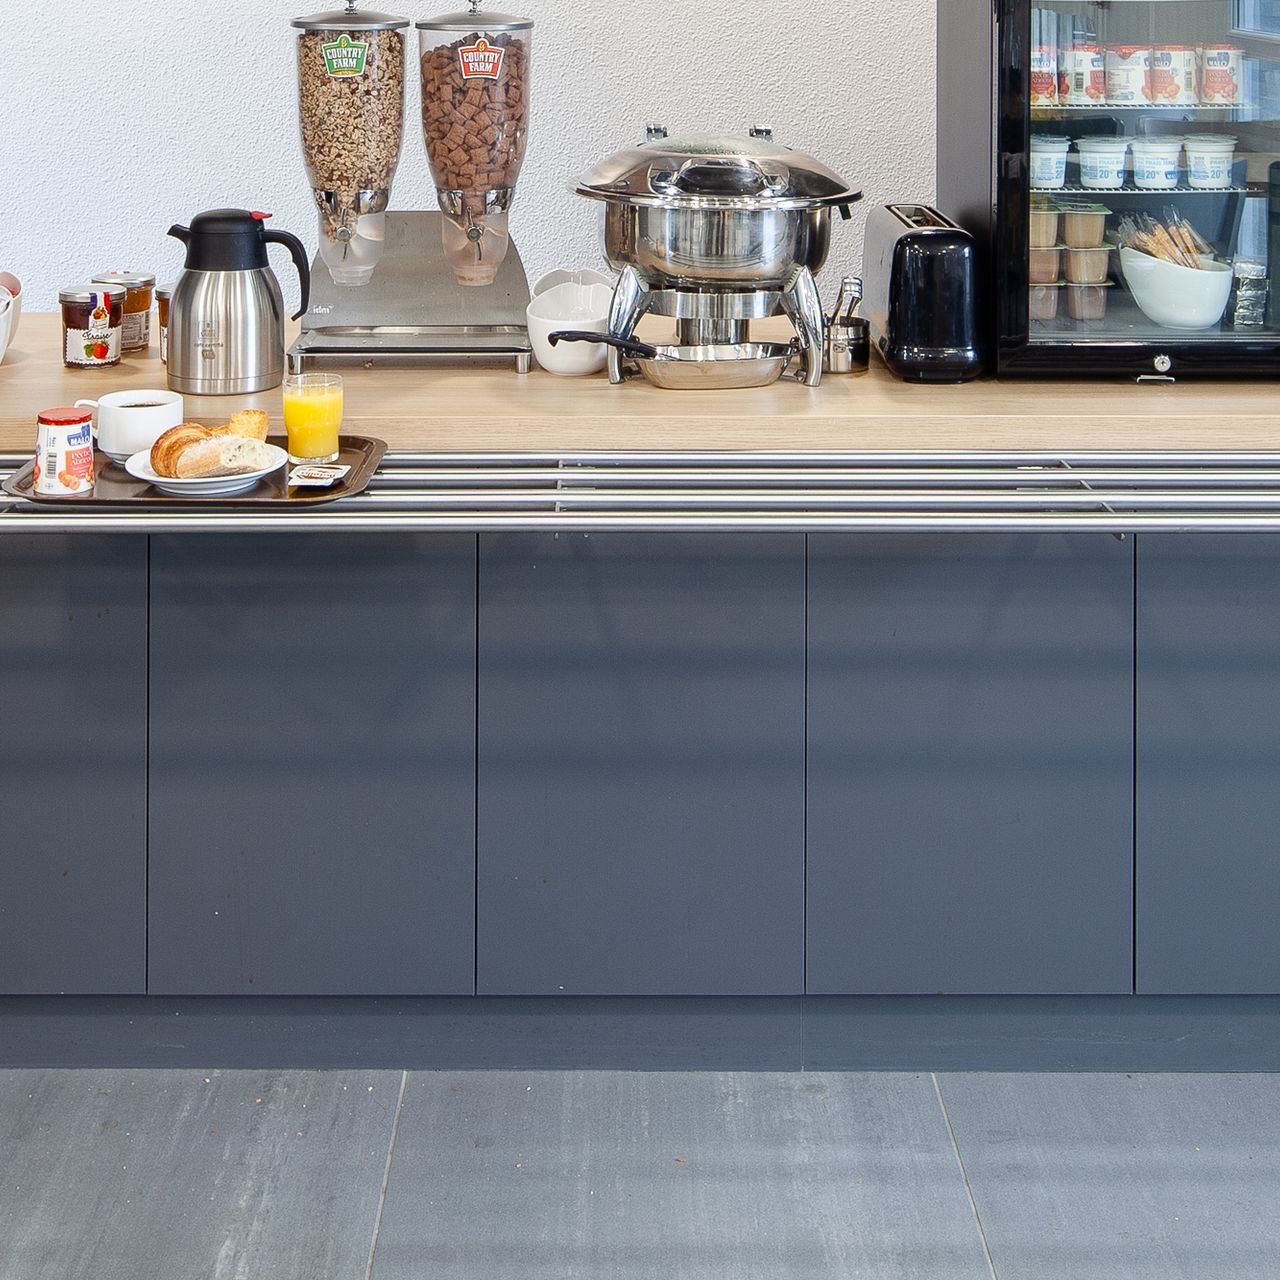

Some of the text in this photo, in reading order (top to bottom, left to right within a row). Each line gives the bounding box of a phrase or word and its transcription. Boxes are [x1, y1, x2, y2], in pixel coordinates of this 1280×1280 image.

[326, 47, 364, 61] COUNTRY
[463, 51, 500, 64] COUNTRY
[333, 57, 357, 69] FARM
[469, 61, 494, 73] FARM
[82, 328, 113, 340] Fraise
